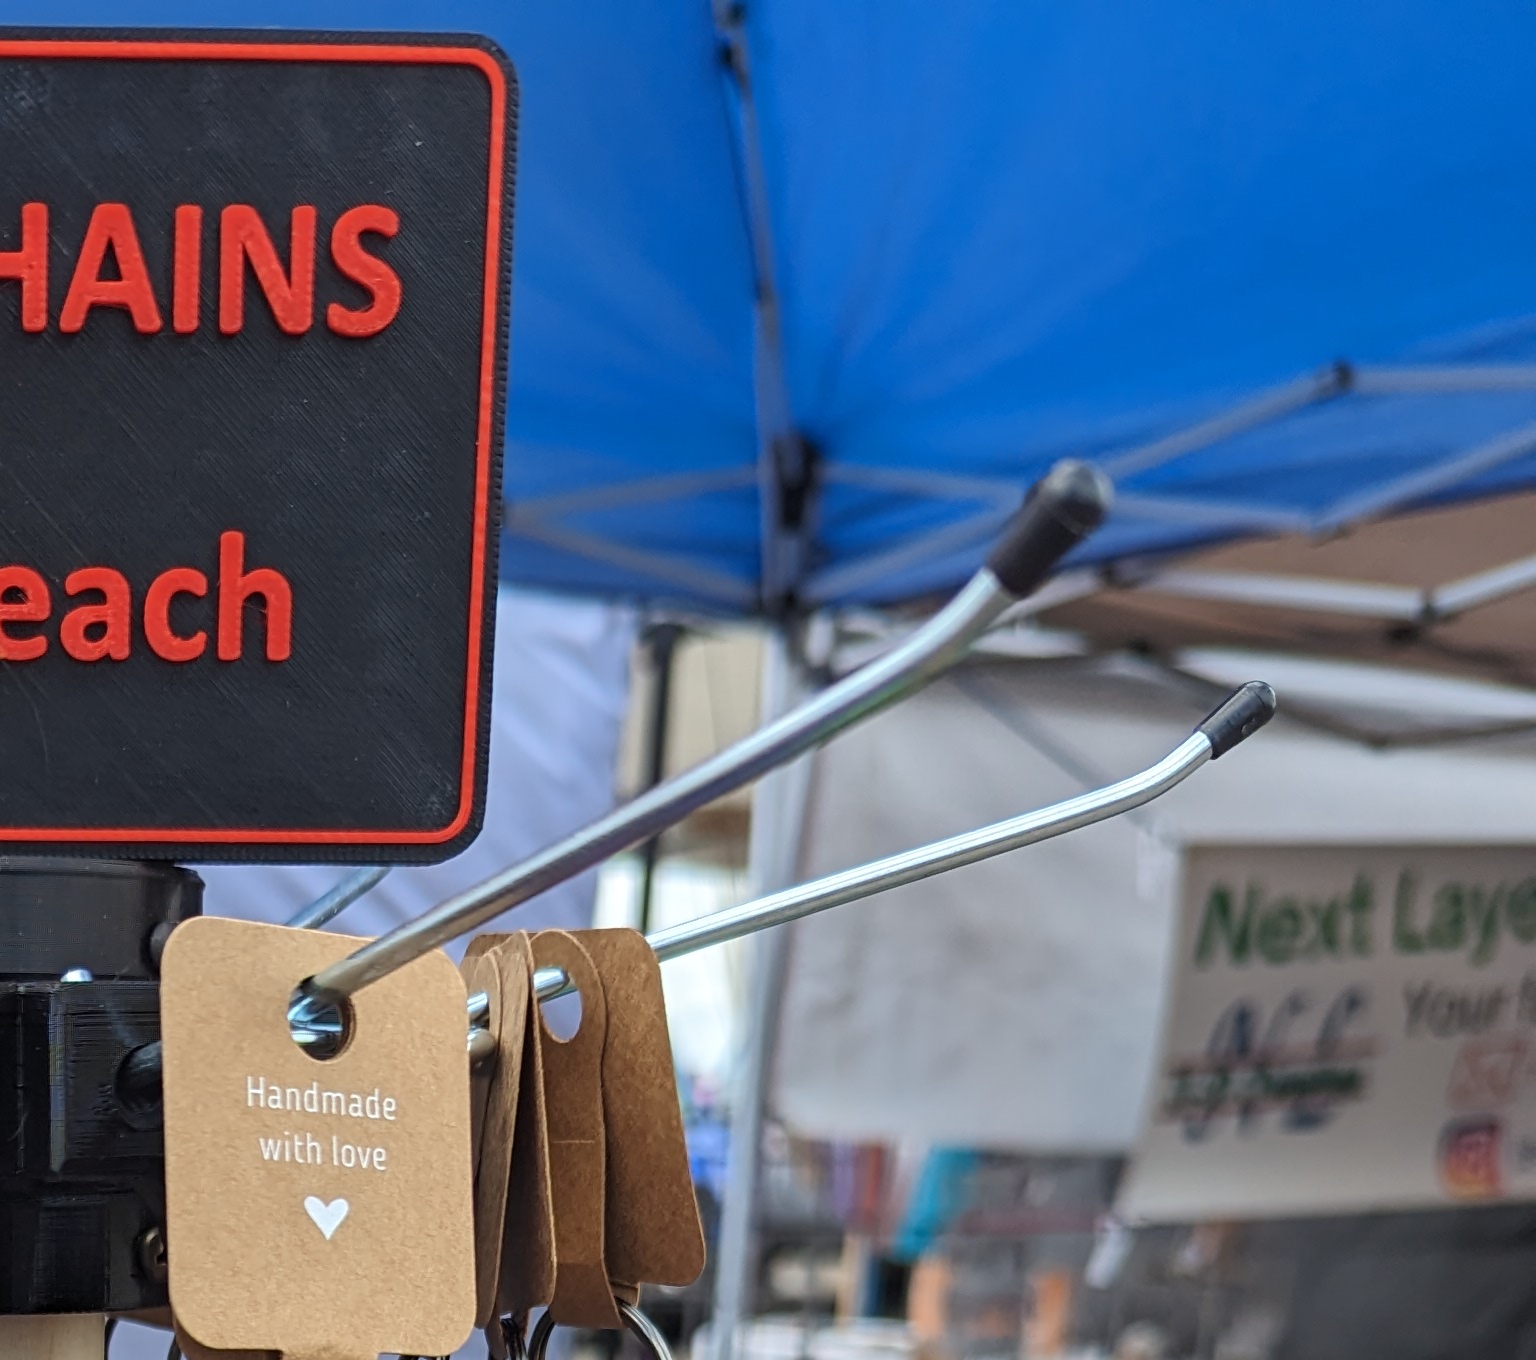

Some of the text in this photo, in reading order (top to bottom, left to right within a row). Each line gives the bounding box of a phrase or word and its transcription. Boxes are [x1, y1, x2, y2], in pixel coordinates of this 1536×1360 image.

[1193, 872, 1374, 969] Next
[246, 1076, 397, 1120] Handmade
[259, 1131, 387, 1171] with love
